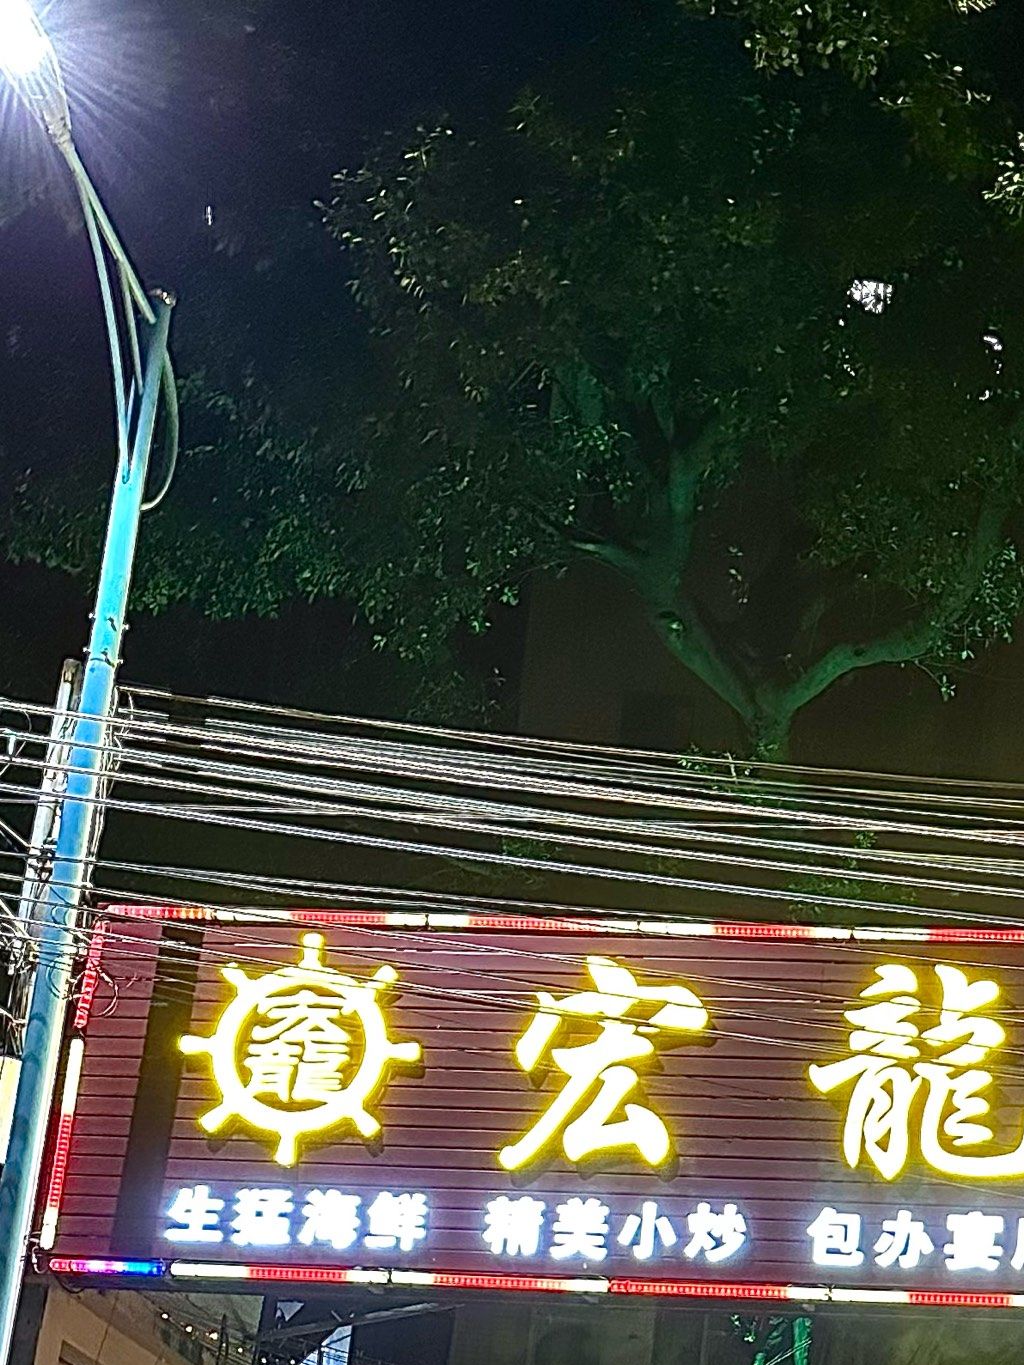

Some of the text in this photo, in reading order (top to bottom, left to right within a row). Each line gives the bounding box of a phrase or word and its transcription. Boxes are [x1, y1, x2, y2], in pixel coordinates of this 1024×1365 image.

[164, 1185, 430, 1253] 生猛海鲜
[482, 1196, 748, 1264] 精美小炒
